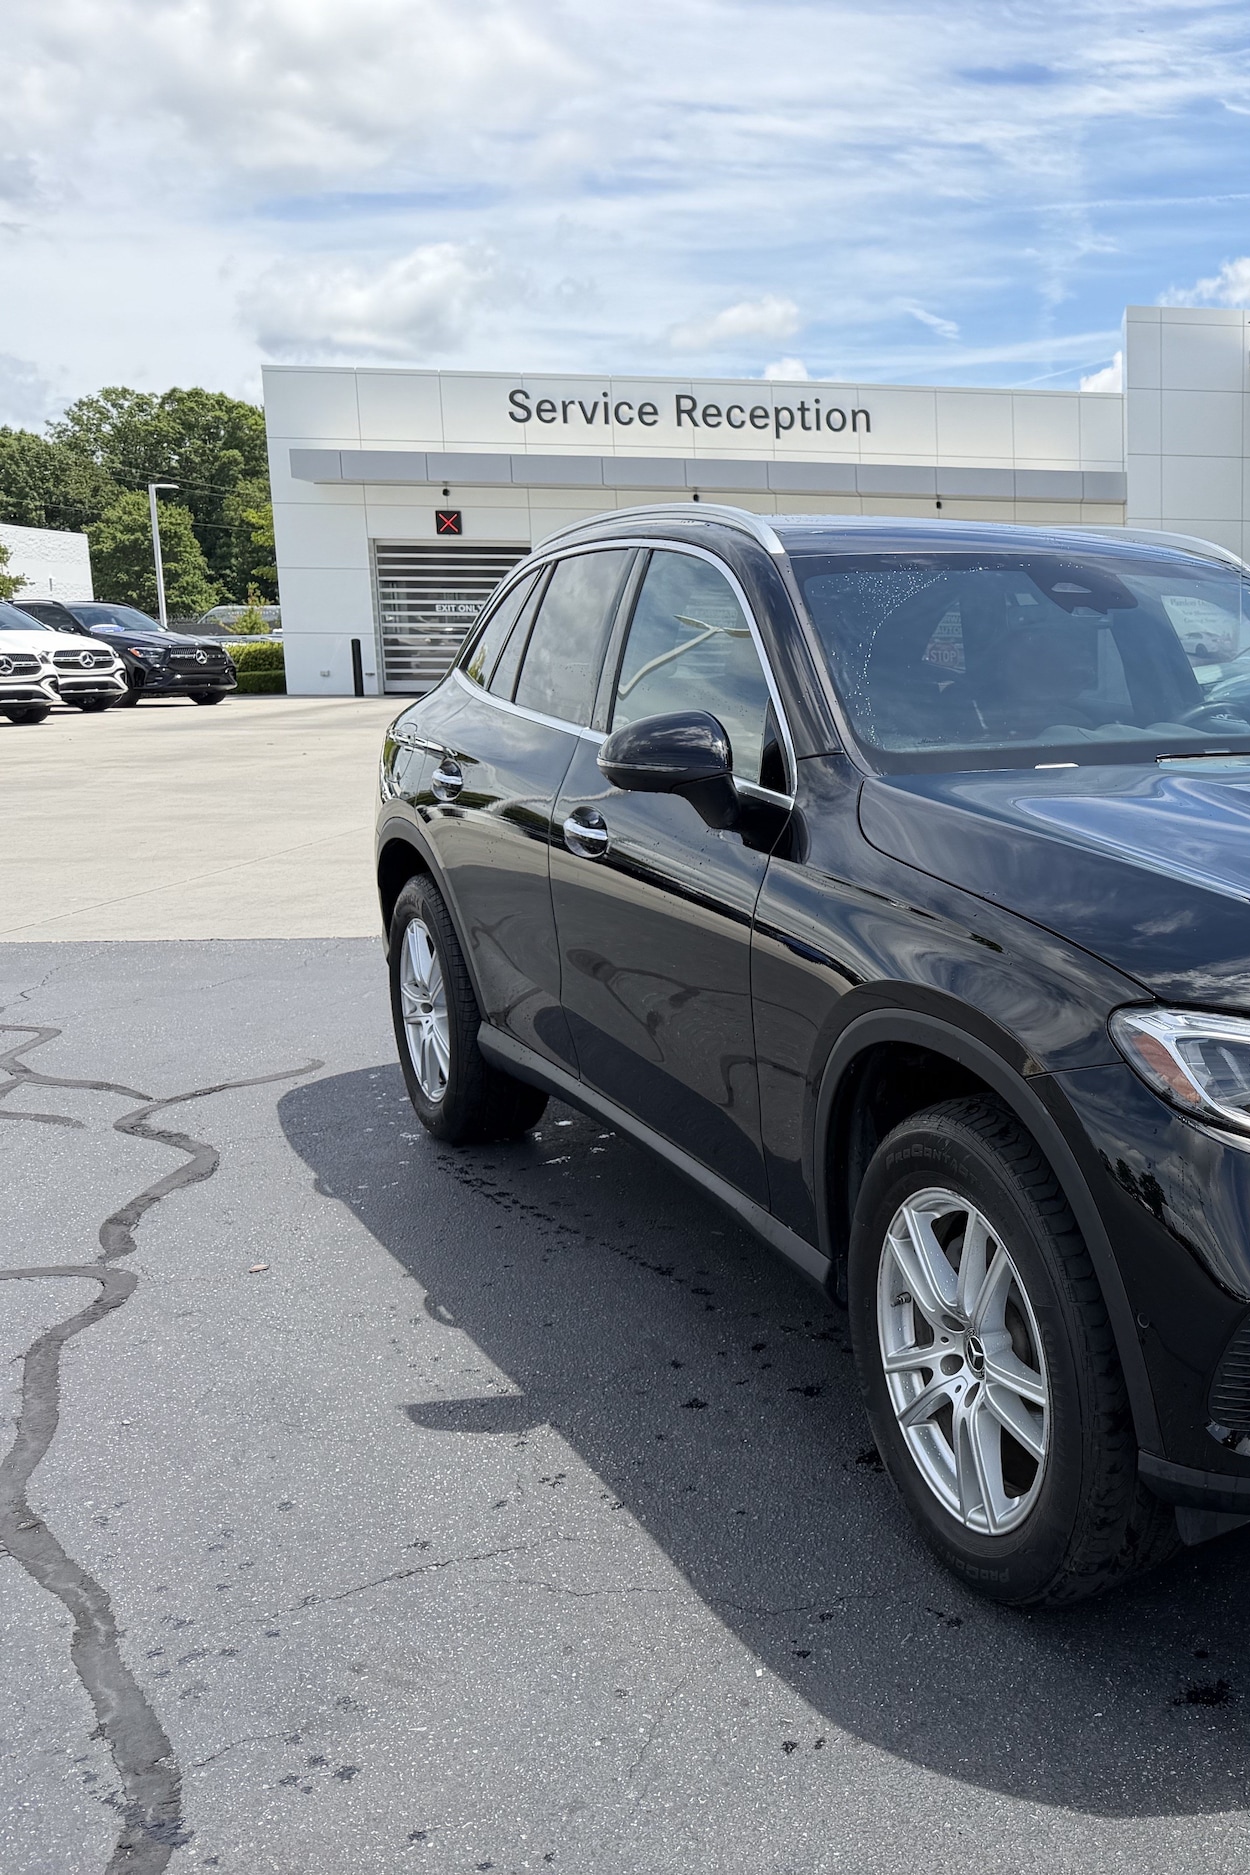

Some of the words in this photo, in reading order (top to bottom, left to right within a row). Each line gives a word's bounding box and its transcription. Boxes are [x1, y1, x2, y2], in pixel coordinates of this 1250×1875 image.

[508, 388, 660, 427] Service
[675, 393, 872, 440] Reception
[435, 604, 457, 613] EXIT
[458, 604, 483, 613] ONLY
[930, 649, 957, 662] STOP
